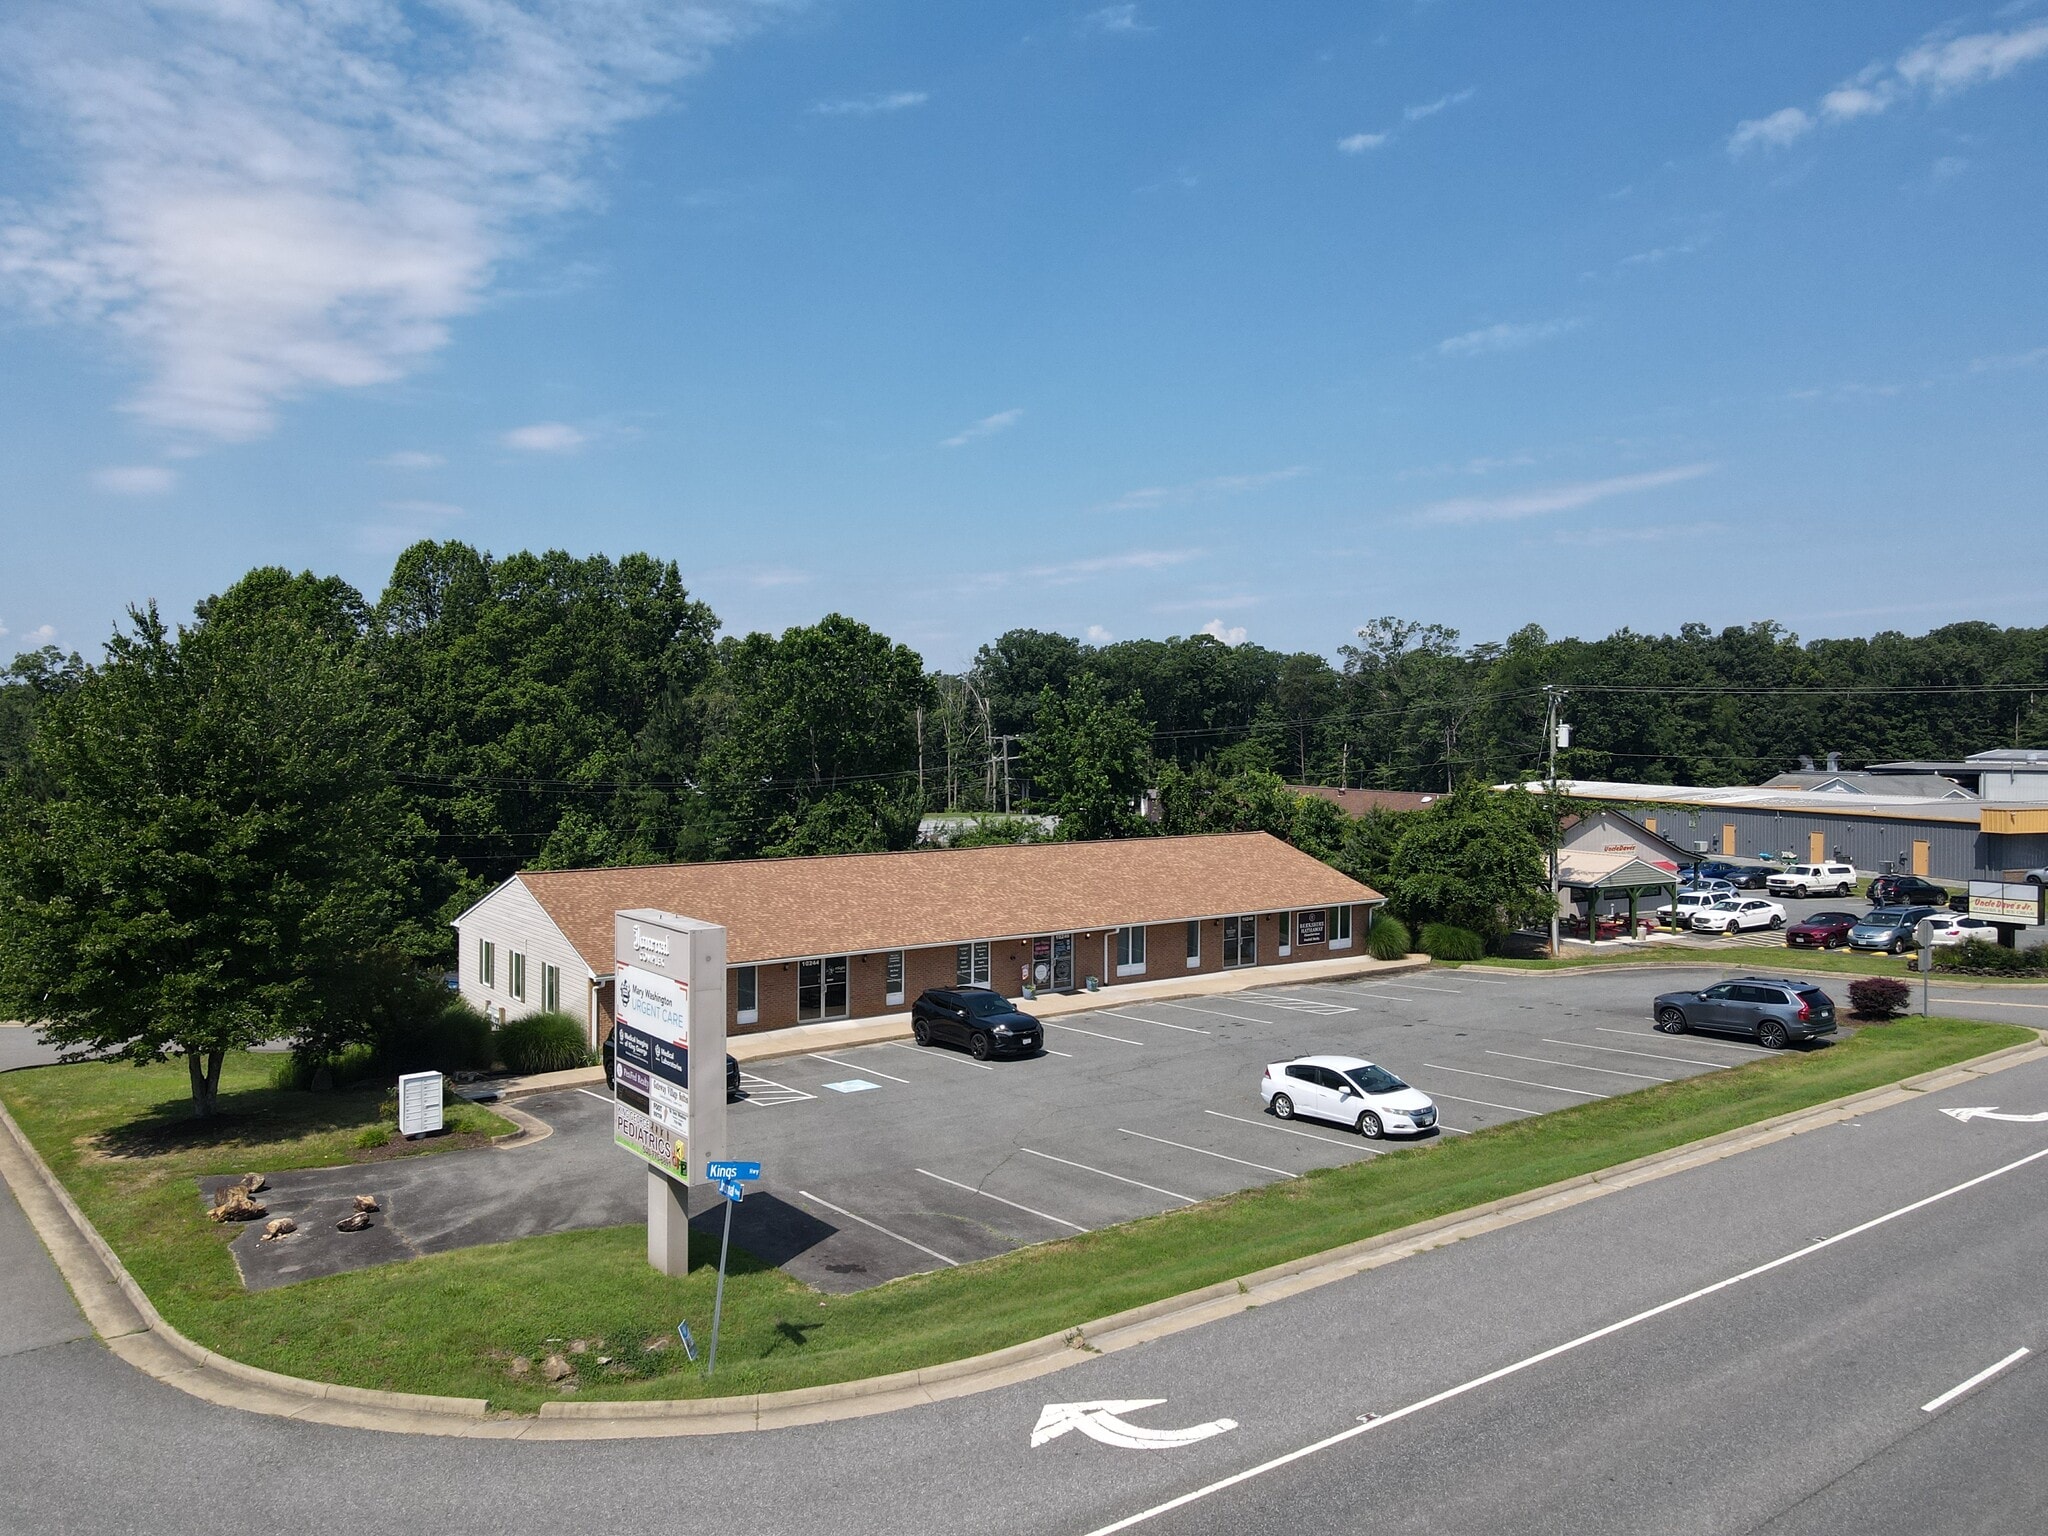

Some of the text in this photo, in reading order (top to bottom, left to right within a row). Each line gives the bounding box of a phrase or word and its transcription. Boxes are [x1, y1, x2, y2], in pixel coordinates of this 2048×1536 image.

[1975, 899, 1995, 907] Uncle
[632, 984, 673, 1007] Mary Washington
[631, 999, 684, 1028] URGENT CARE
[617, 1116, 671, 1158] PEDIATRICS
[709, 1164, 737, 1179] Kings
